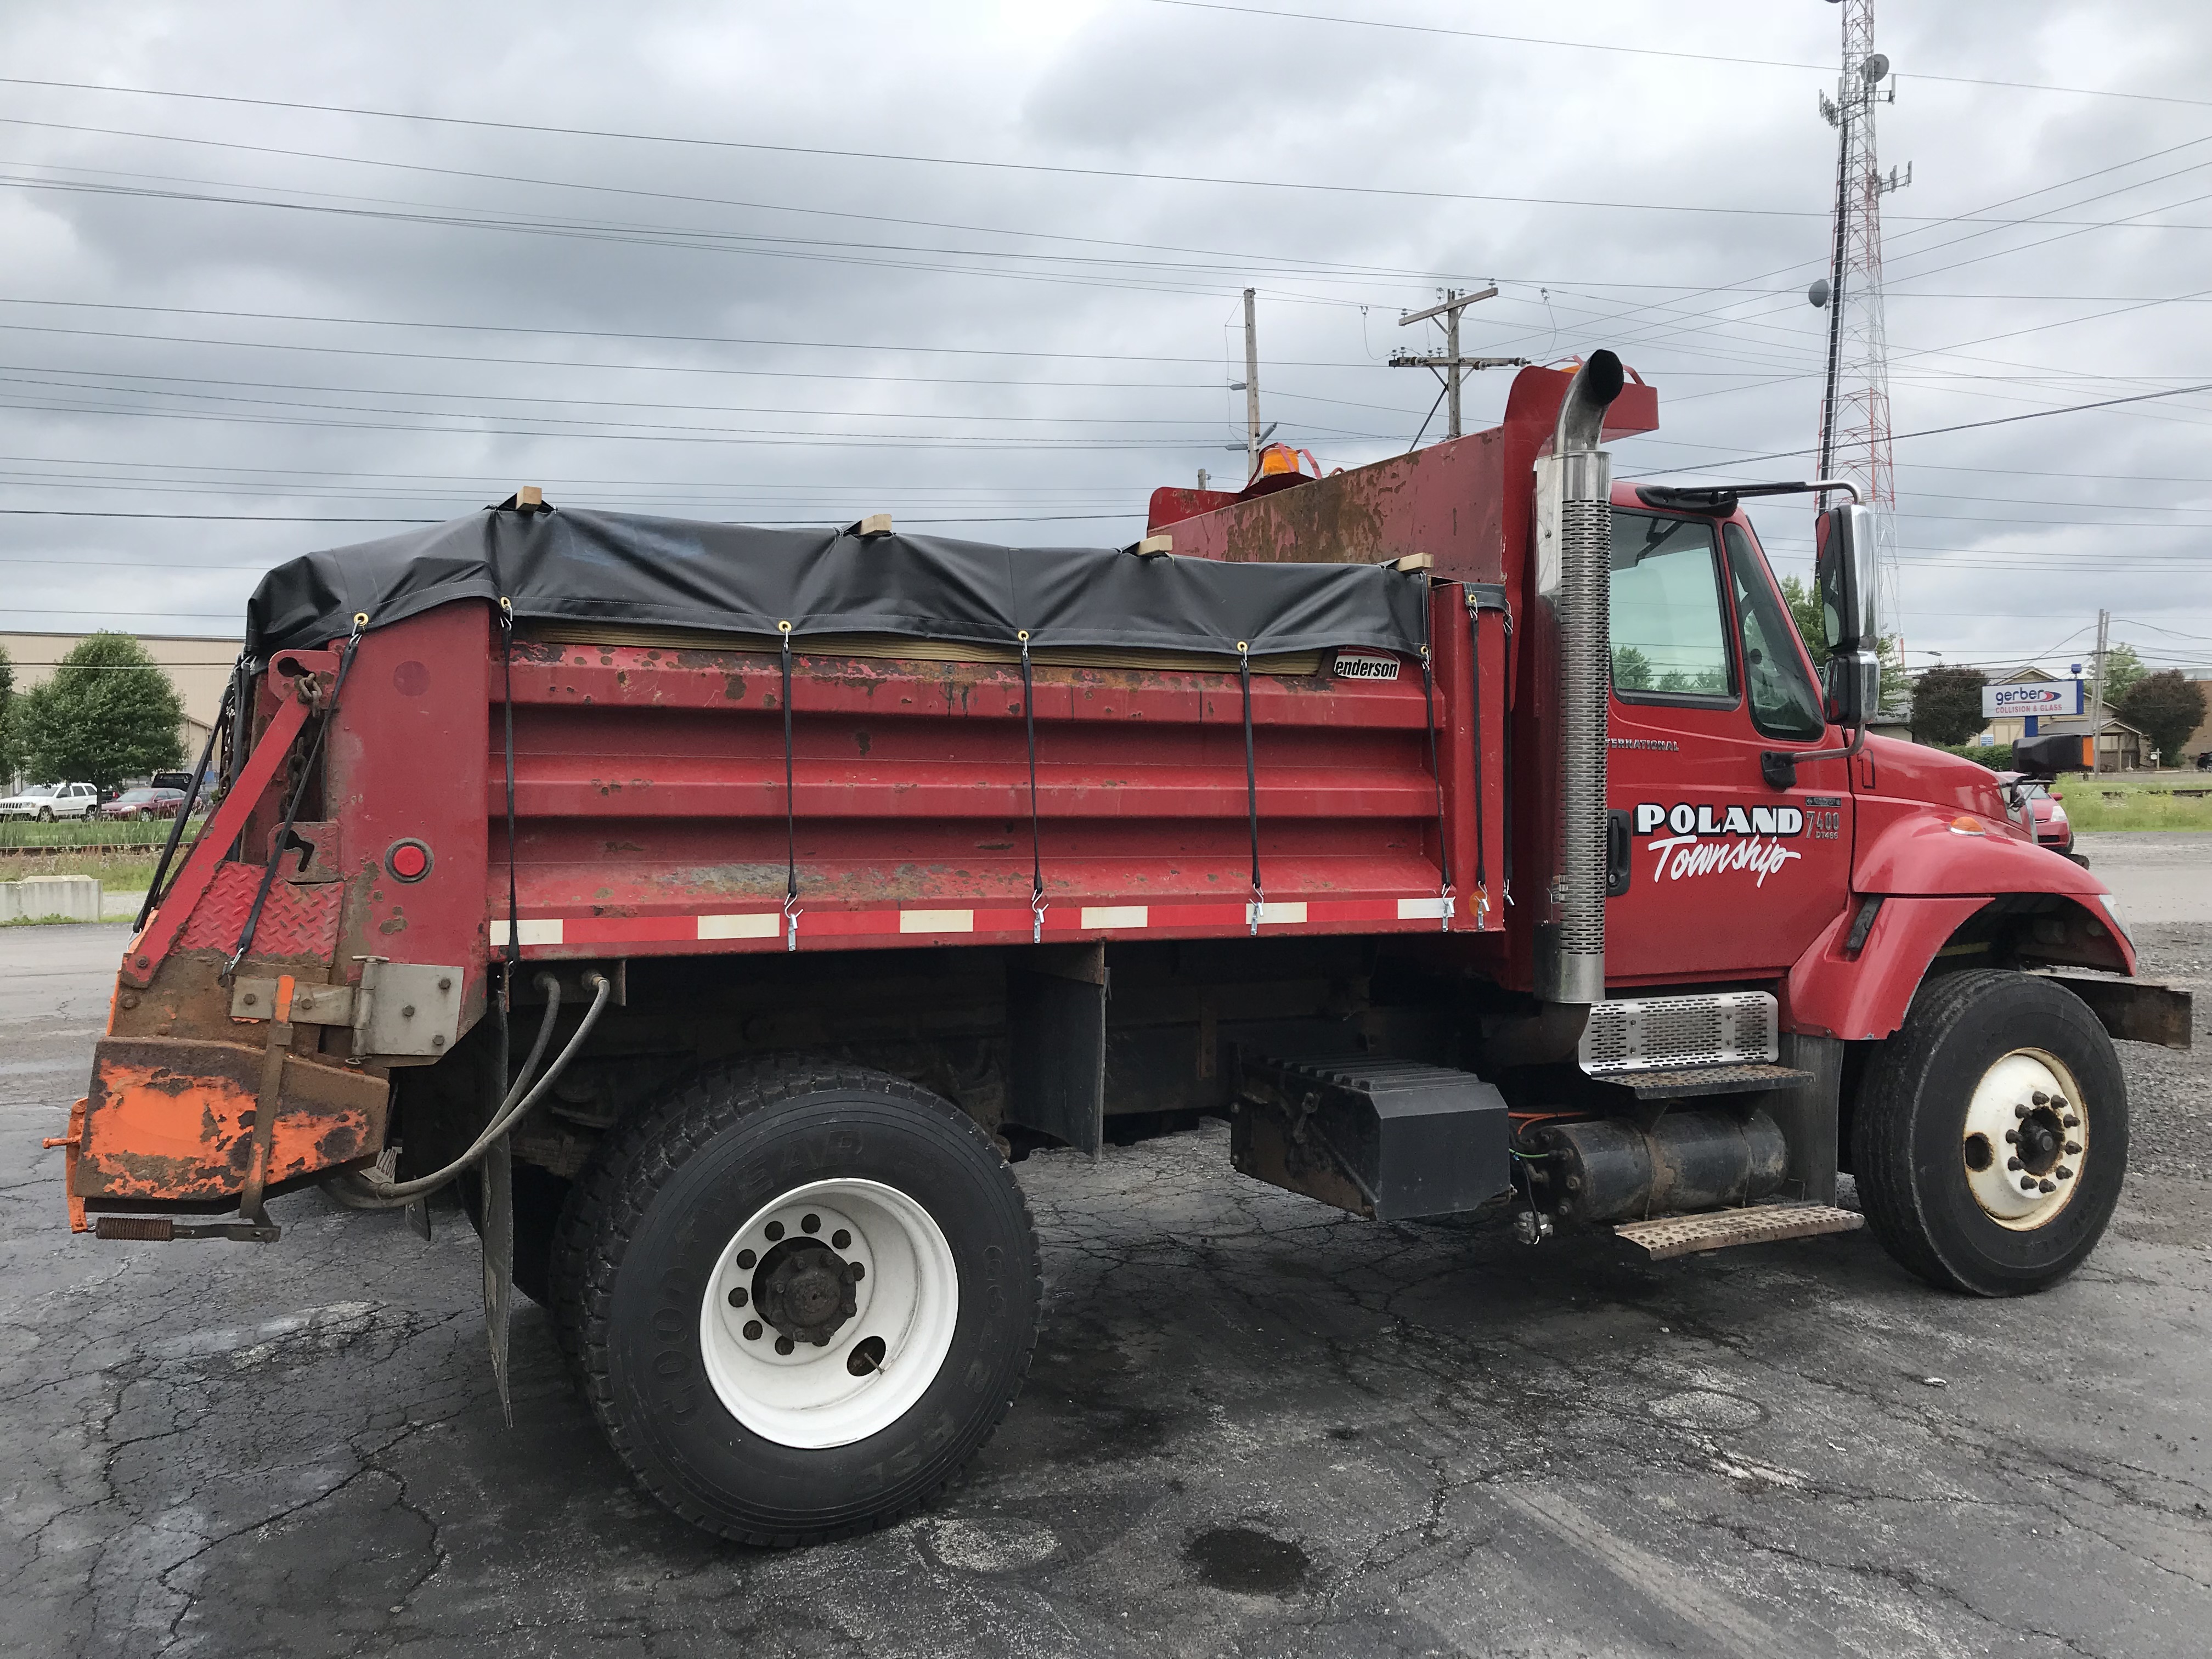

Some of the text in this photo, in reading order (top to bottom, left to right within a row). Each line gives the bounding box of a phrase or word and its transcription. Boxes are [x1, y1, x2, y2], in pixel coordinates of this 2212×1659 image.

[1335, 659, 1398, 678] enderson
[1995, 687, 2045, 706] gerber
[1634, 803, 1803, 836] POLAND
[1806, 811, 1839, 839] 7400
[1648, 834, 1802, 888] Township
